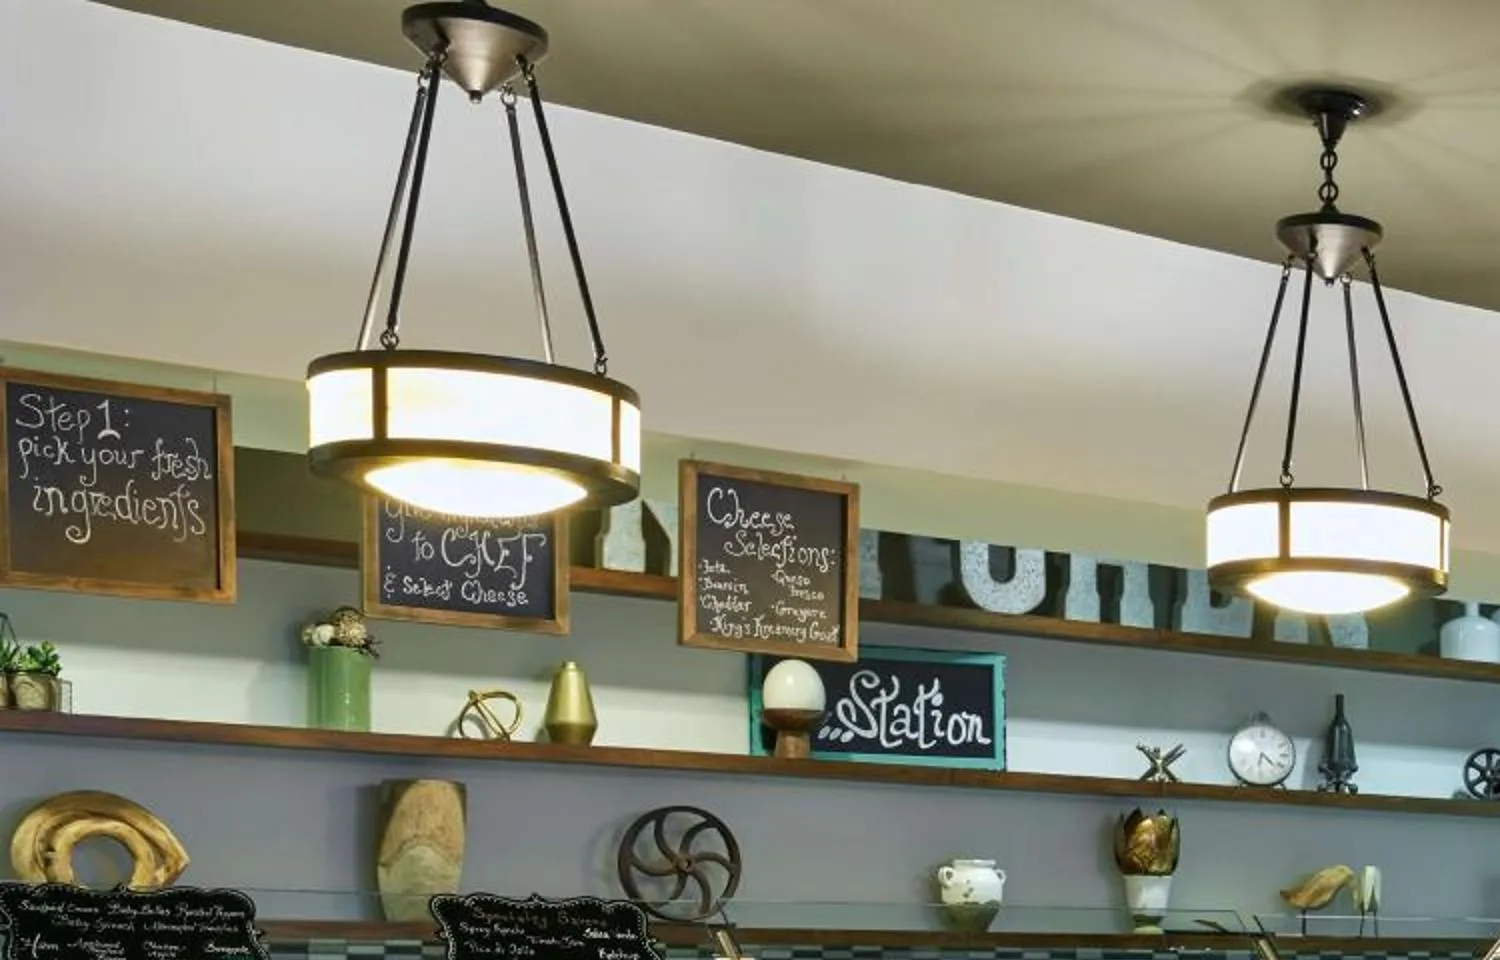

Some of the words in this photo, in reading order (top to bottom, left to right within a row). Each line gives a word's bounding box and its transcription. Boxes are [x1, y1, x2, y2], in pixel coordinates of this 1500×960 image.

[16, 393, 91, 444] Step
[18, 436, 76, 479] pick
[80, 446, 144, 487] your
[151, 437, 212, 481] fresh
[33, 477, 206, 543] ingredients
[707, 487, 795, 536] Cheese
[411, 530, 435, 562] to
[461, 579, 529, 607] Cheese
